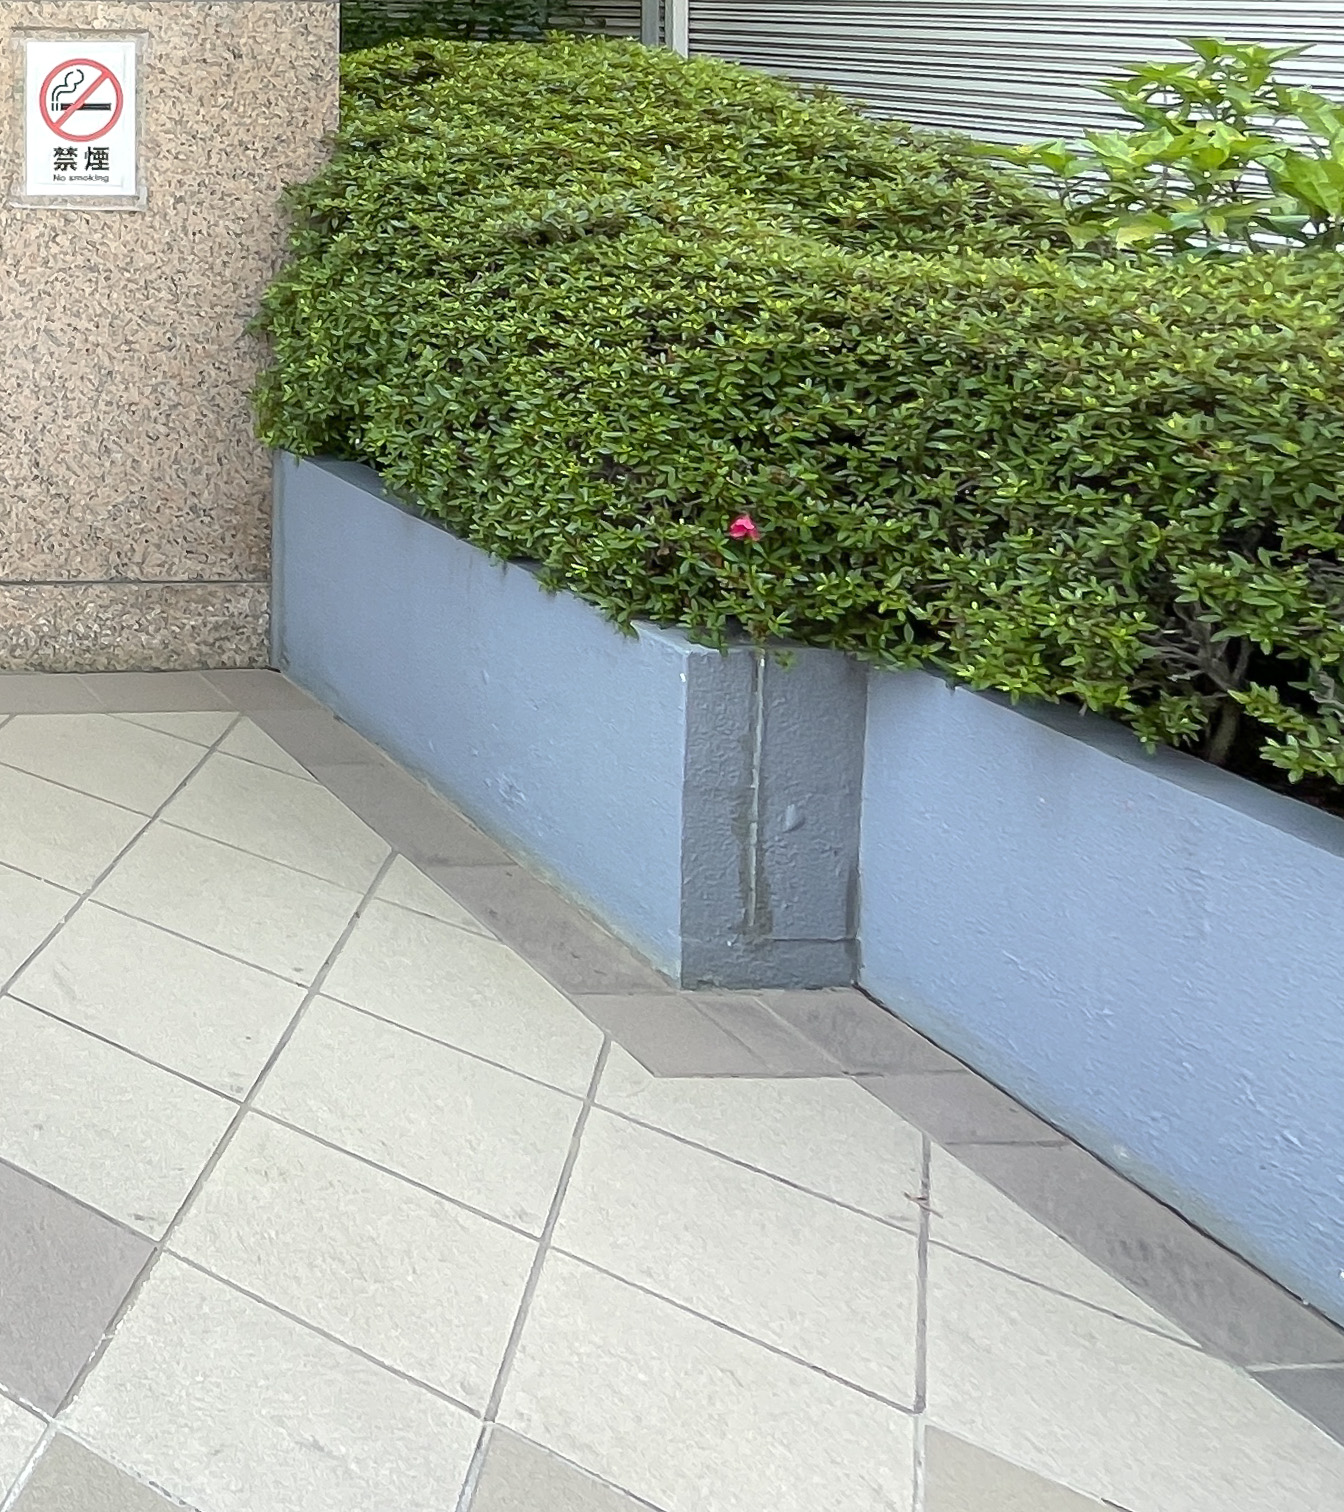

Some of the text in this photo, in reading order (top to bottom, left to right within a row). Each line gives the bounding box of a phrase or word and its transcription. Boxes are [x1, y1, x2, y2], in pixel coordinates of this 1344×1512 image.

[53, 146, 110, 171] 禁煙
[53, 174, 110, 183] No smoking
